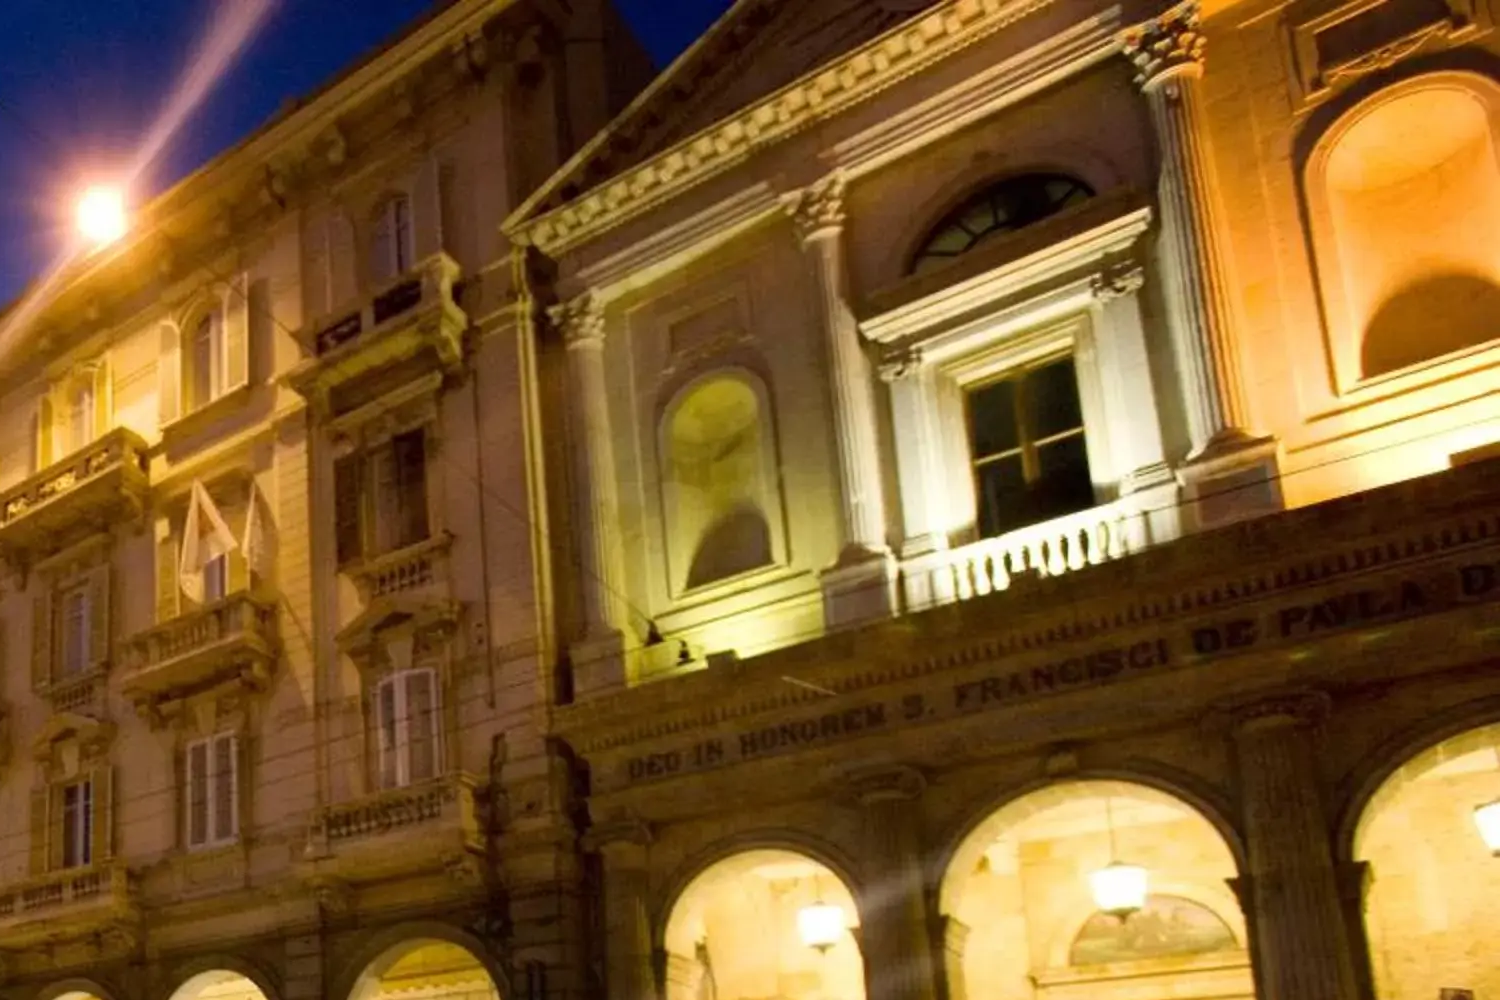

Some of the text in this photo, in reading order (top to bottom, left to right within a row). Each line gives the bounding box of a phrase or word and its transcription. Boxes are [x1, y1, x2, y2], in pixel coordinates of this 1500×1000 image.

[628, 752, 681, 780] DEO
[693, 740, 724, 766] IN
[739, 702, 887, 757] HONOREM
[954, 638, 1169, 707] FRANCISCI
[1192, 619, 1257, 654] DE
